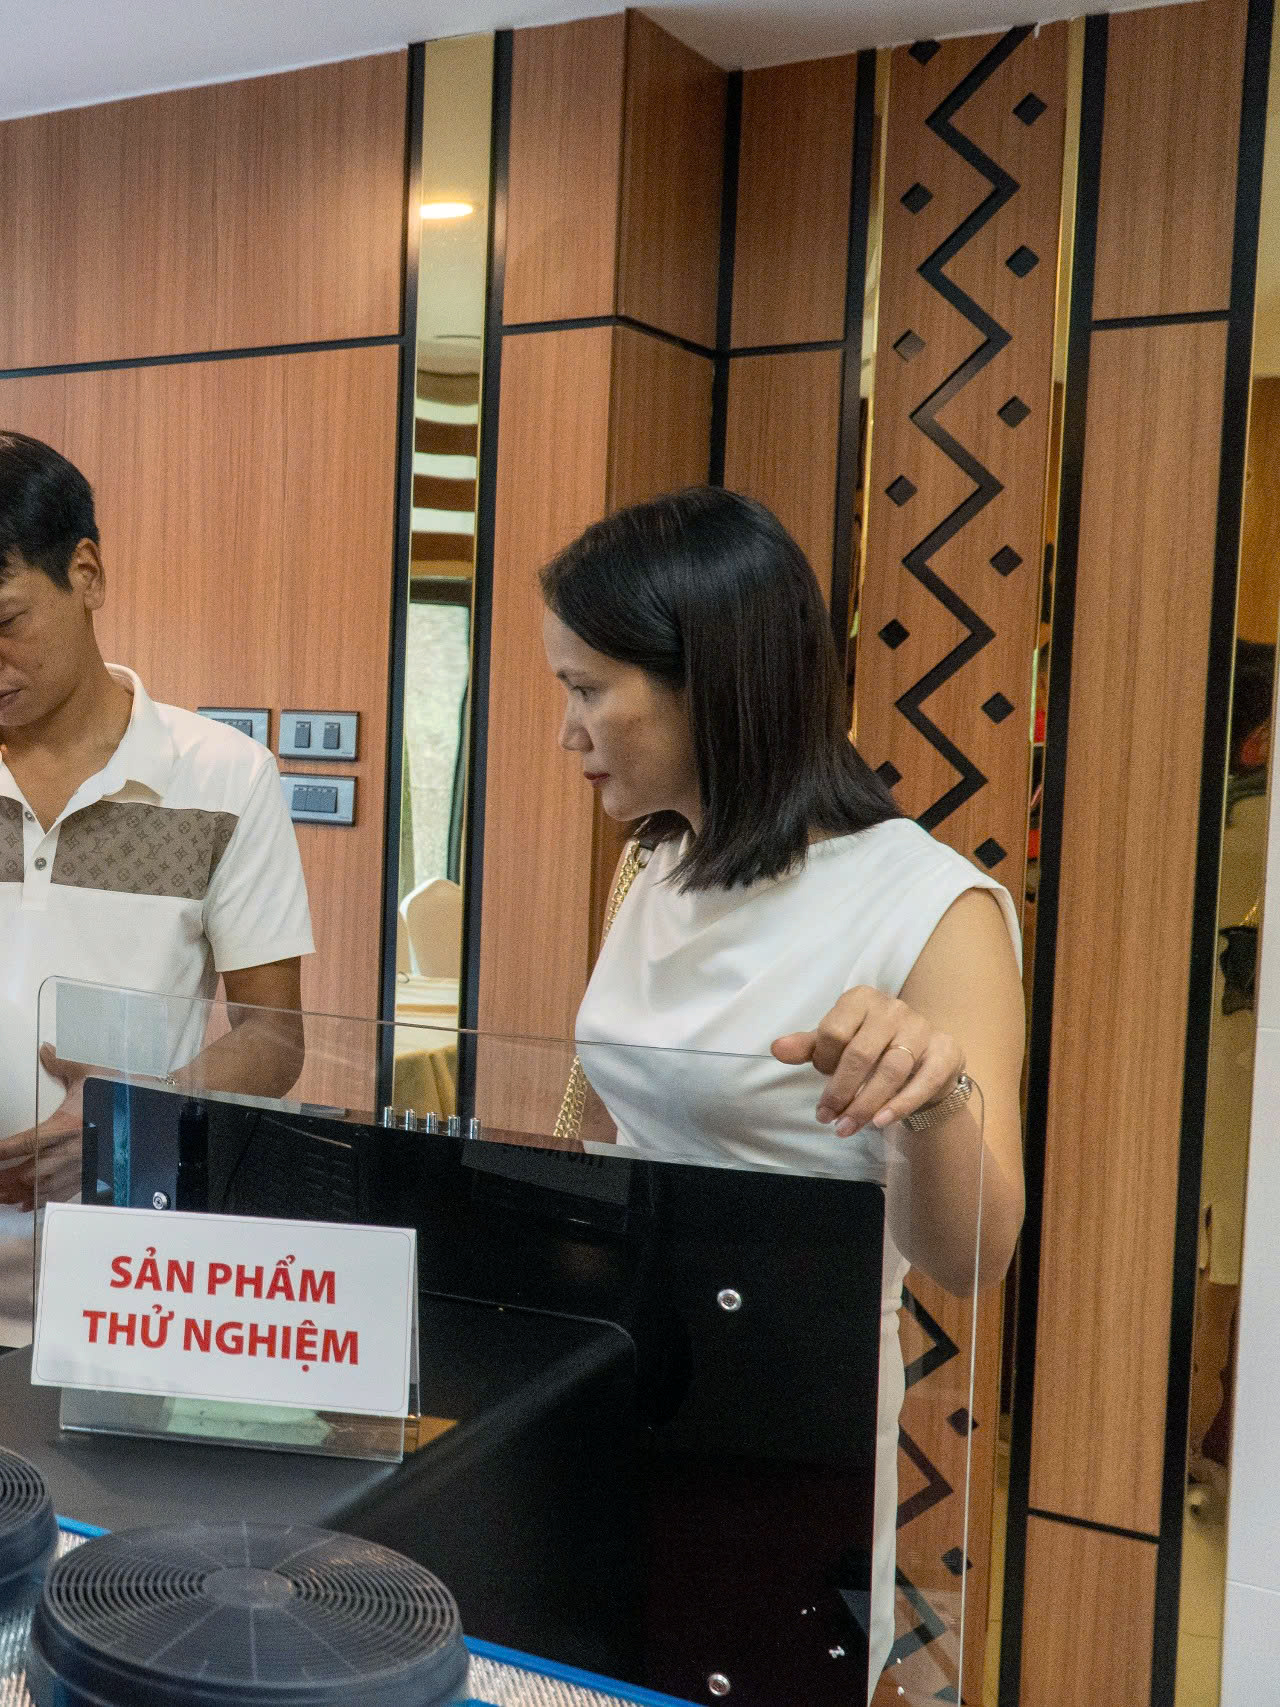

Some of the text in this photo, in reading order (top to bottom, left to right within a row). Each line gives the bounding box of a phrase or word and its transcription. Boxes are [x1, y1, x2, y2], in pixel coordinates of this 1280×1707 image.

[109, 1246, 336, 1305] SẢN PHẨM
[83, 1304, 360, 1373] THỬ NGHIỆM
